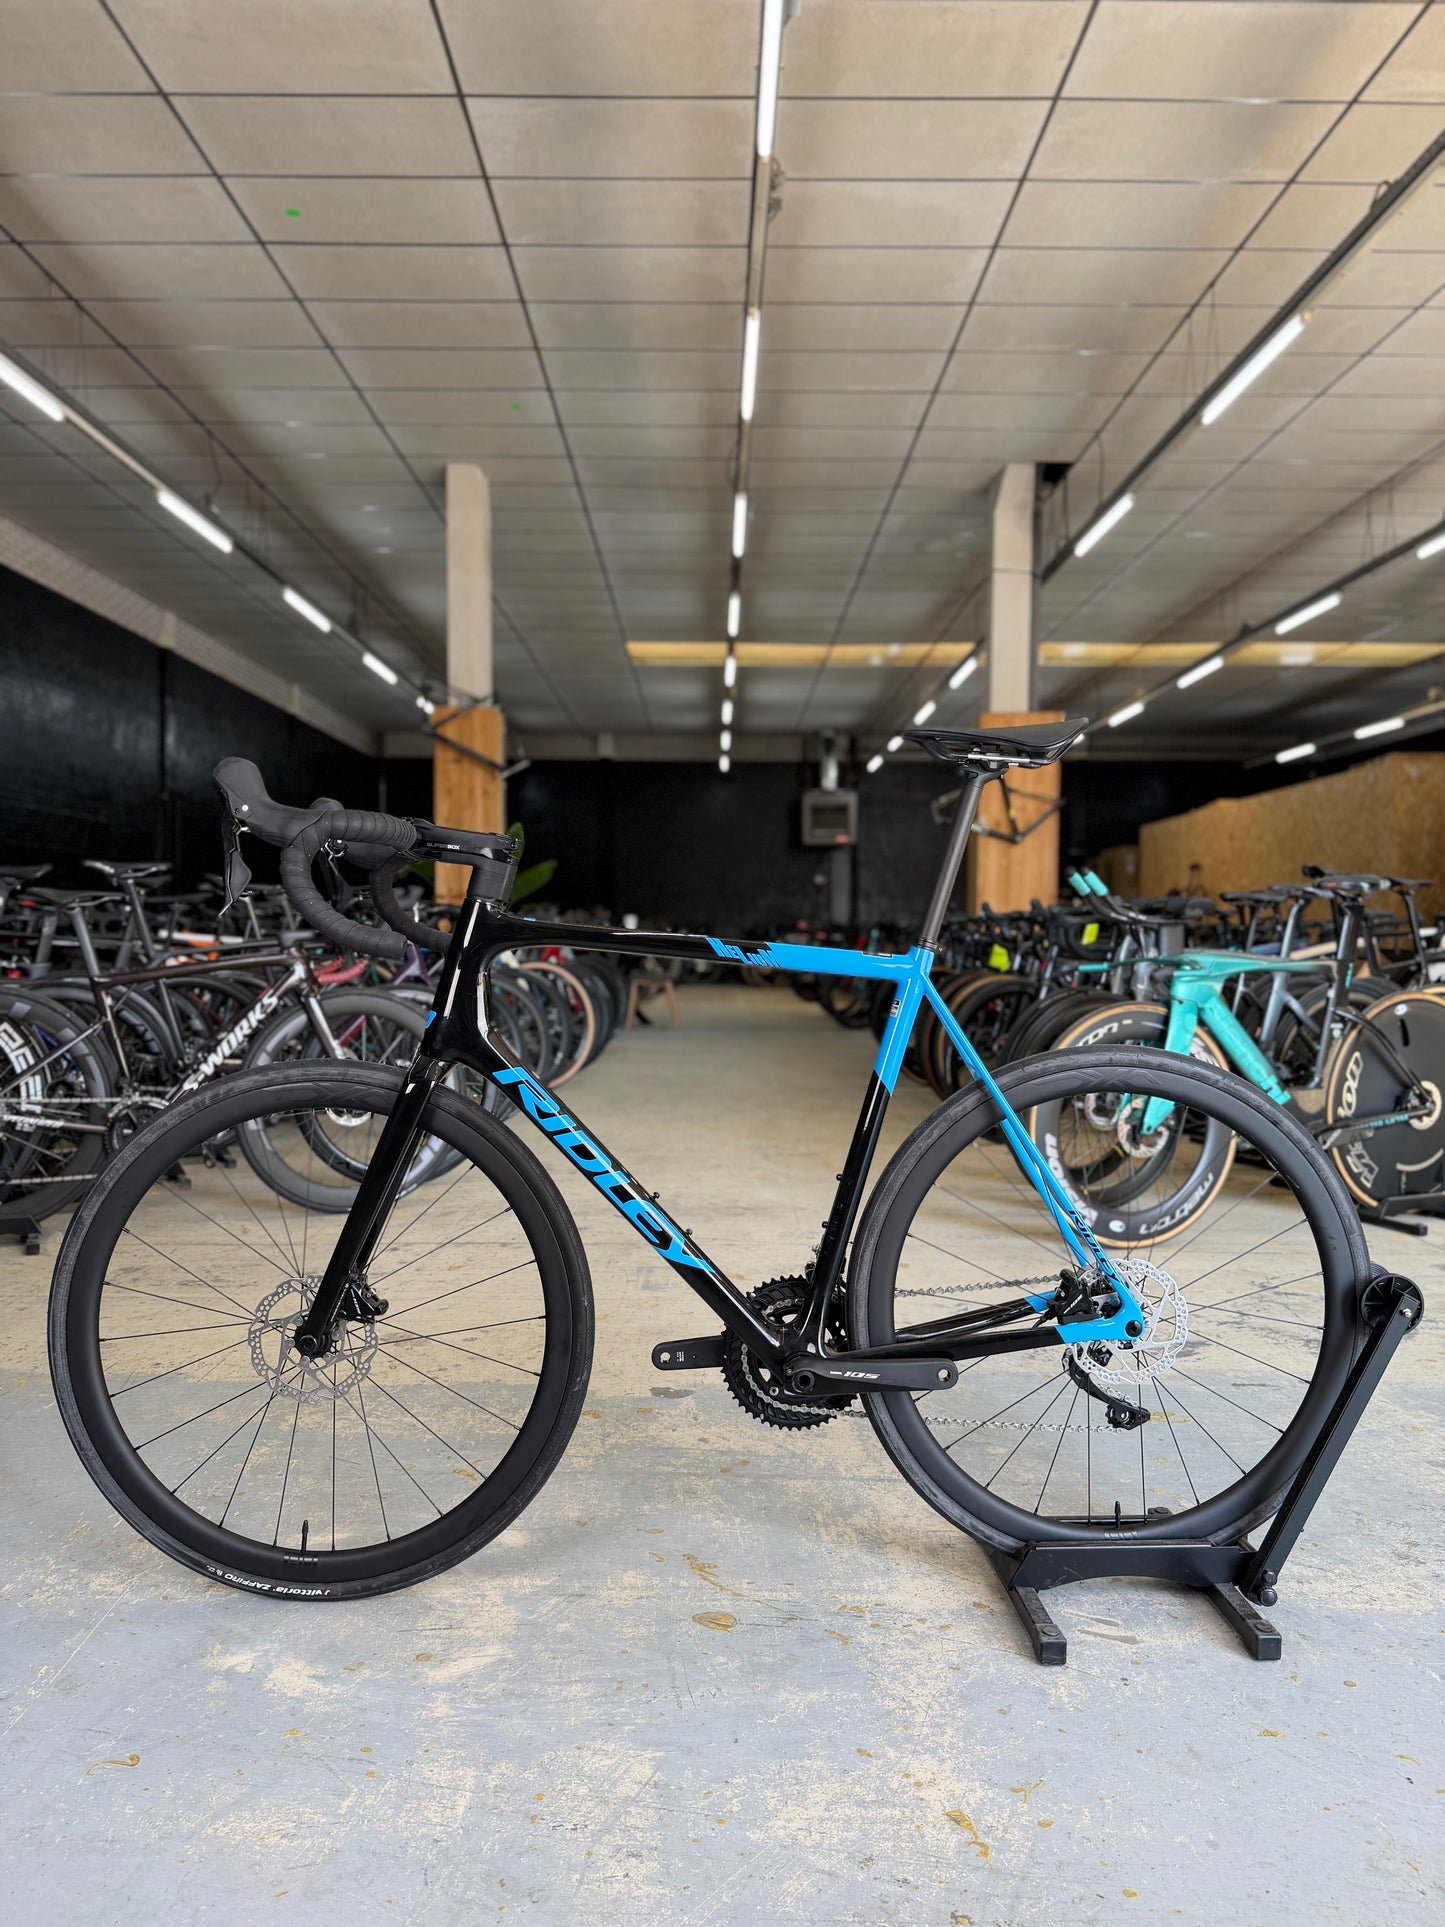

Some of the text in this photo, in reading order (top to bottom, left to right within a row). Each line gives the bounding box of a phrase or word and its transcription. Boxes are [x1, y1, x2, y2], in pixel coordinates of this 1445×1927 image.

[183, 988, 279, 1091] S-WORKS
[492, 1066, 716, 1274] RIDLEY
[1069, 1211, 1120, 1282] RIDLEY
[843, 1370, 880, 1380] 105
[224, 1573, 323, 1596] vittoria ZAFFIRO
